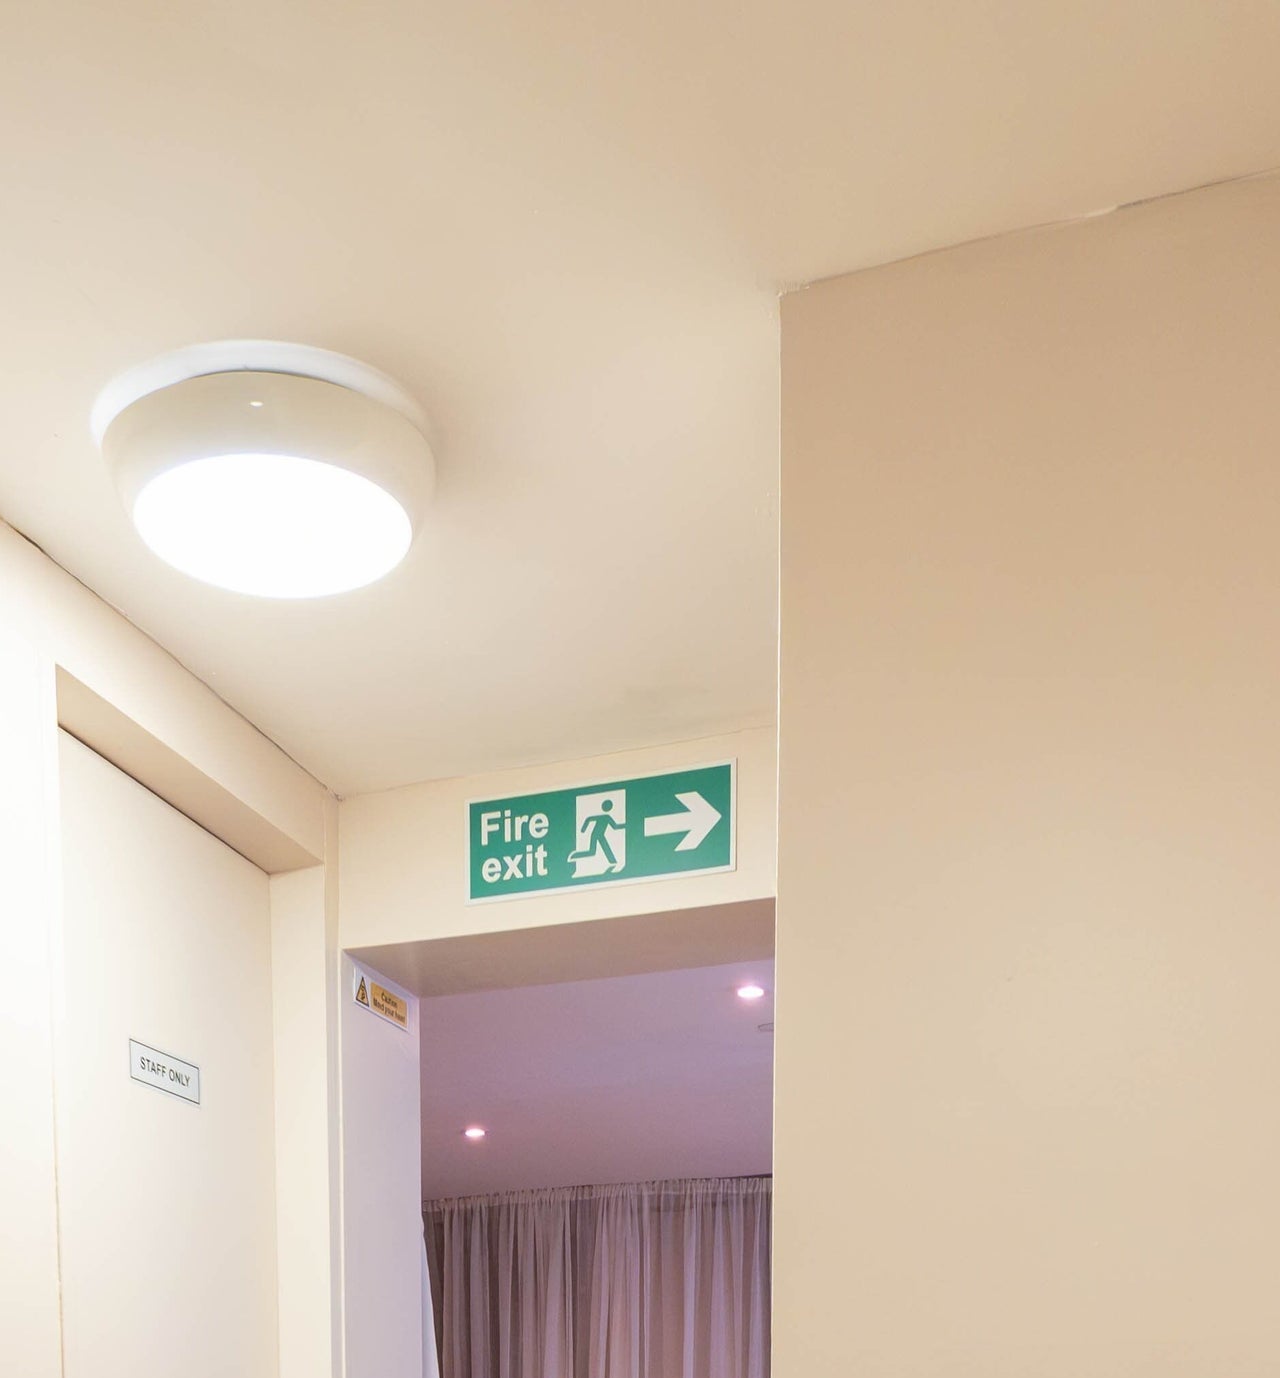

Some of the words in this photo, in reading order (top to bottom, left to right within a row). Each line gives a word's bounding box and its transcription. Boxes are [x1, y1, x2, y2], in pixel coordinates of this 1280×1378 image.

[481, 809, 549, 846] Fire
[481, 843, 548, 883] exit
[140, 1056, 167, 1077] STAFF
[168, 1068, 191, 1087] ONLY
